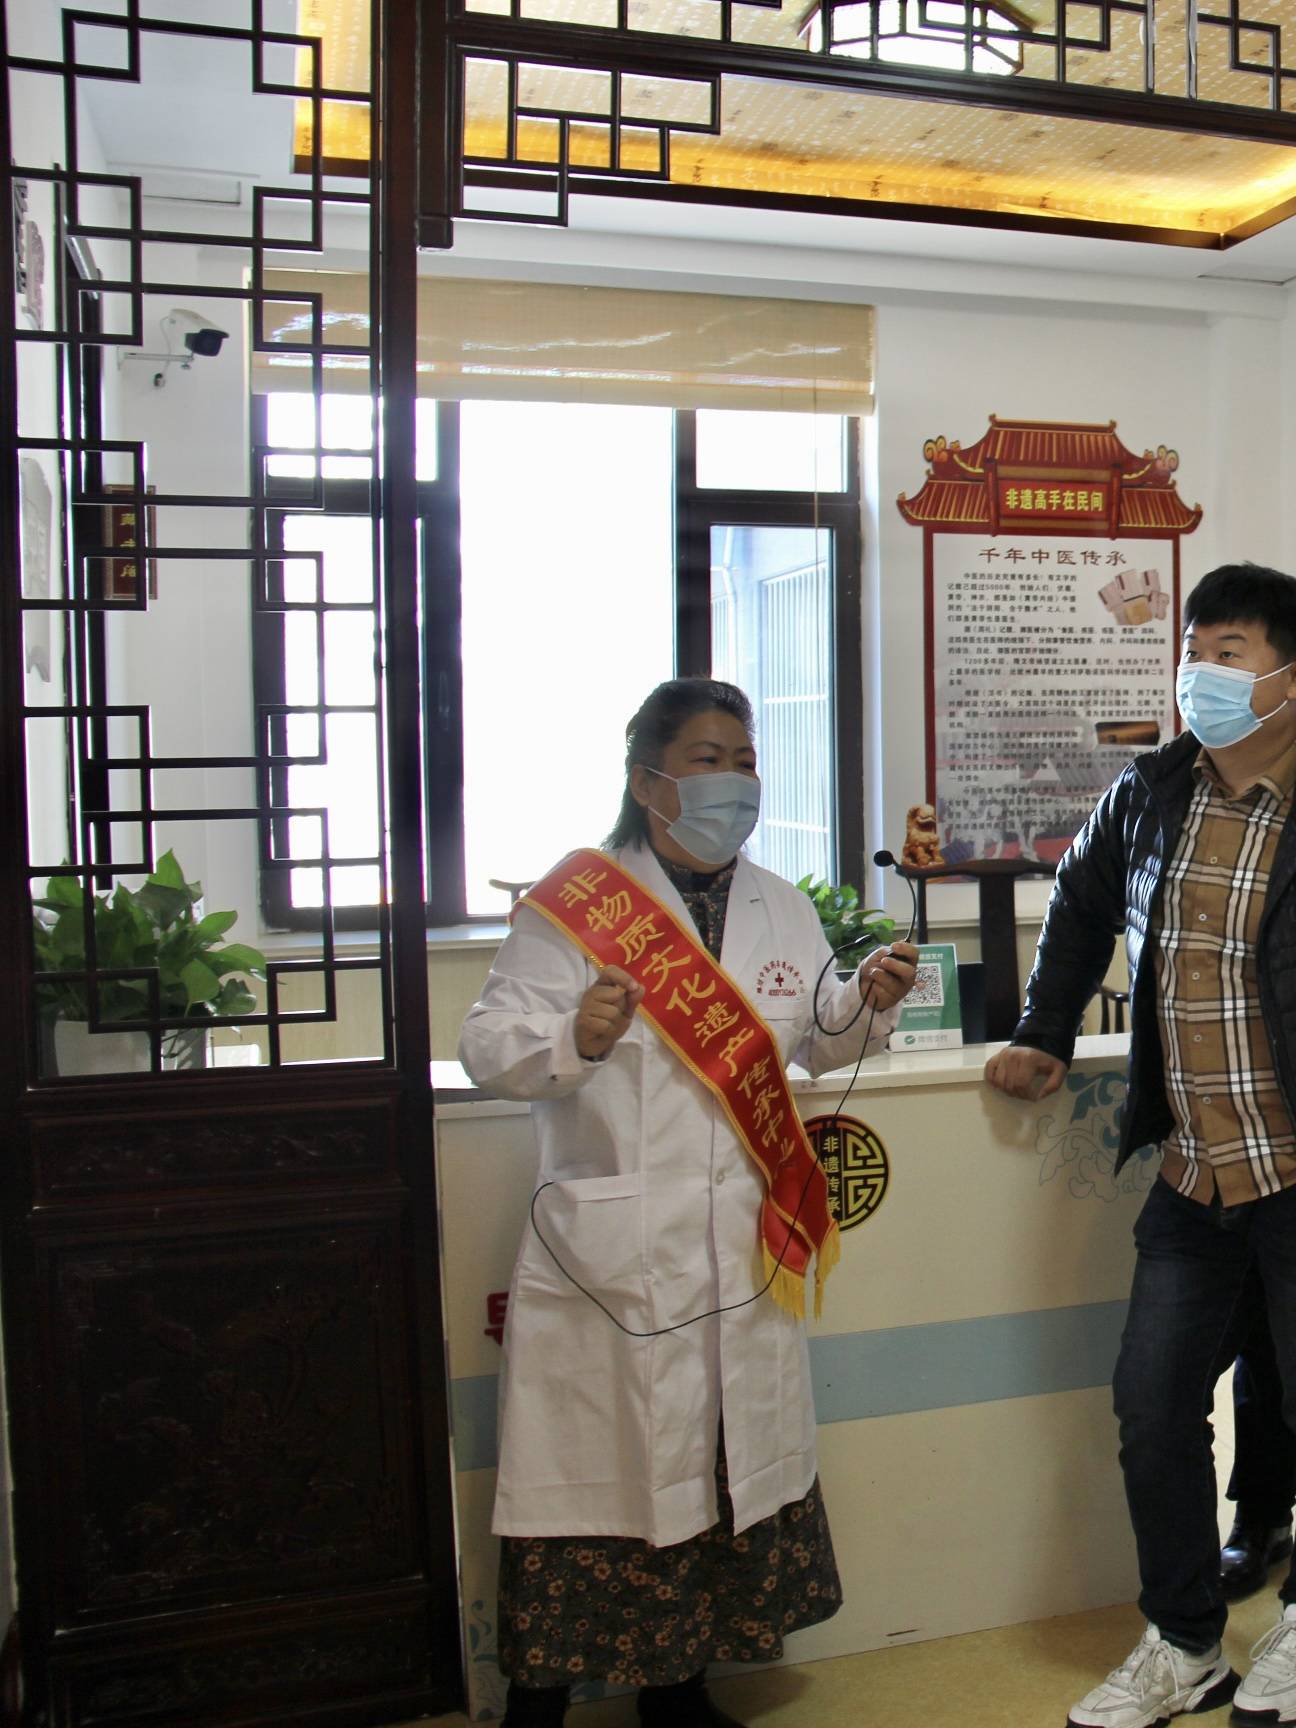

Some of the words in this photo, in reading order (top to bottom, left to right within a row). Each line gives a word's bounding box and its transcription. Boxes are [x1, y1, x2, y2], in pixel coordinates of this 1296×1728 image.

[1005, 488, 1103, 512] 非遗高手在民间
[979, 547, 1128, 567] 千年中医传承
